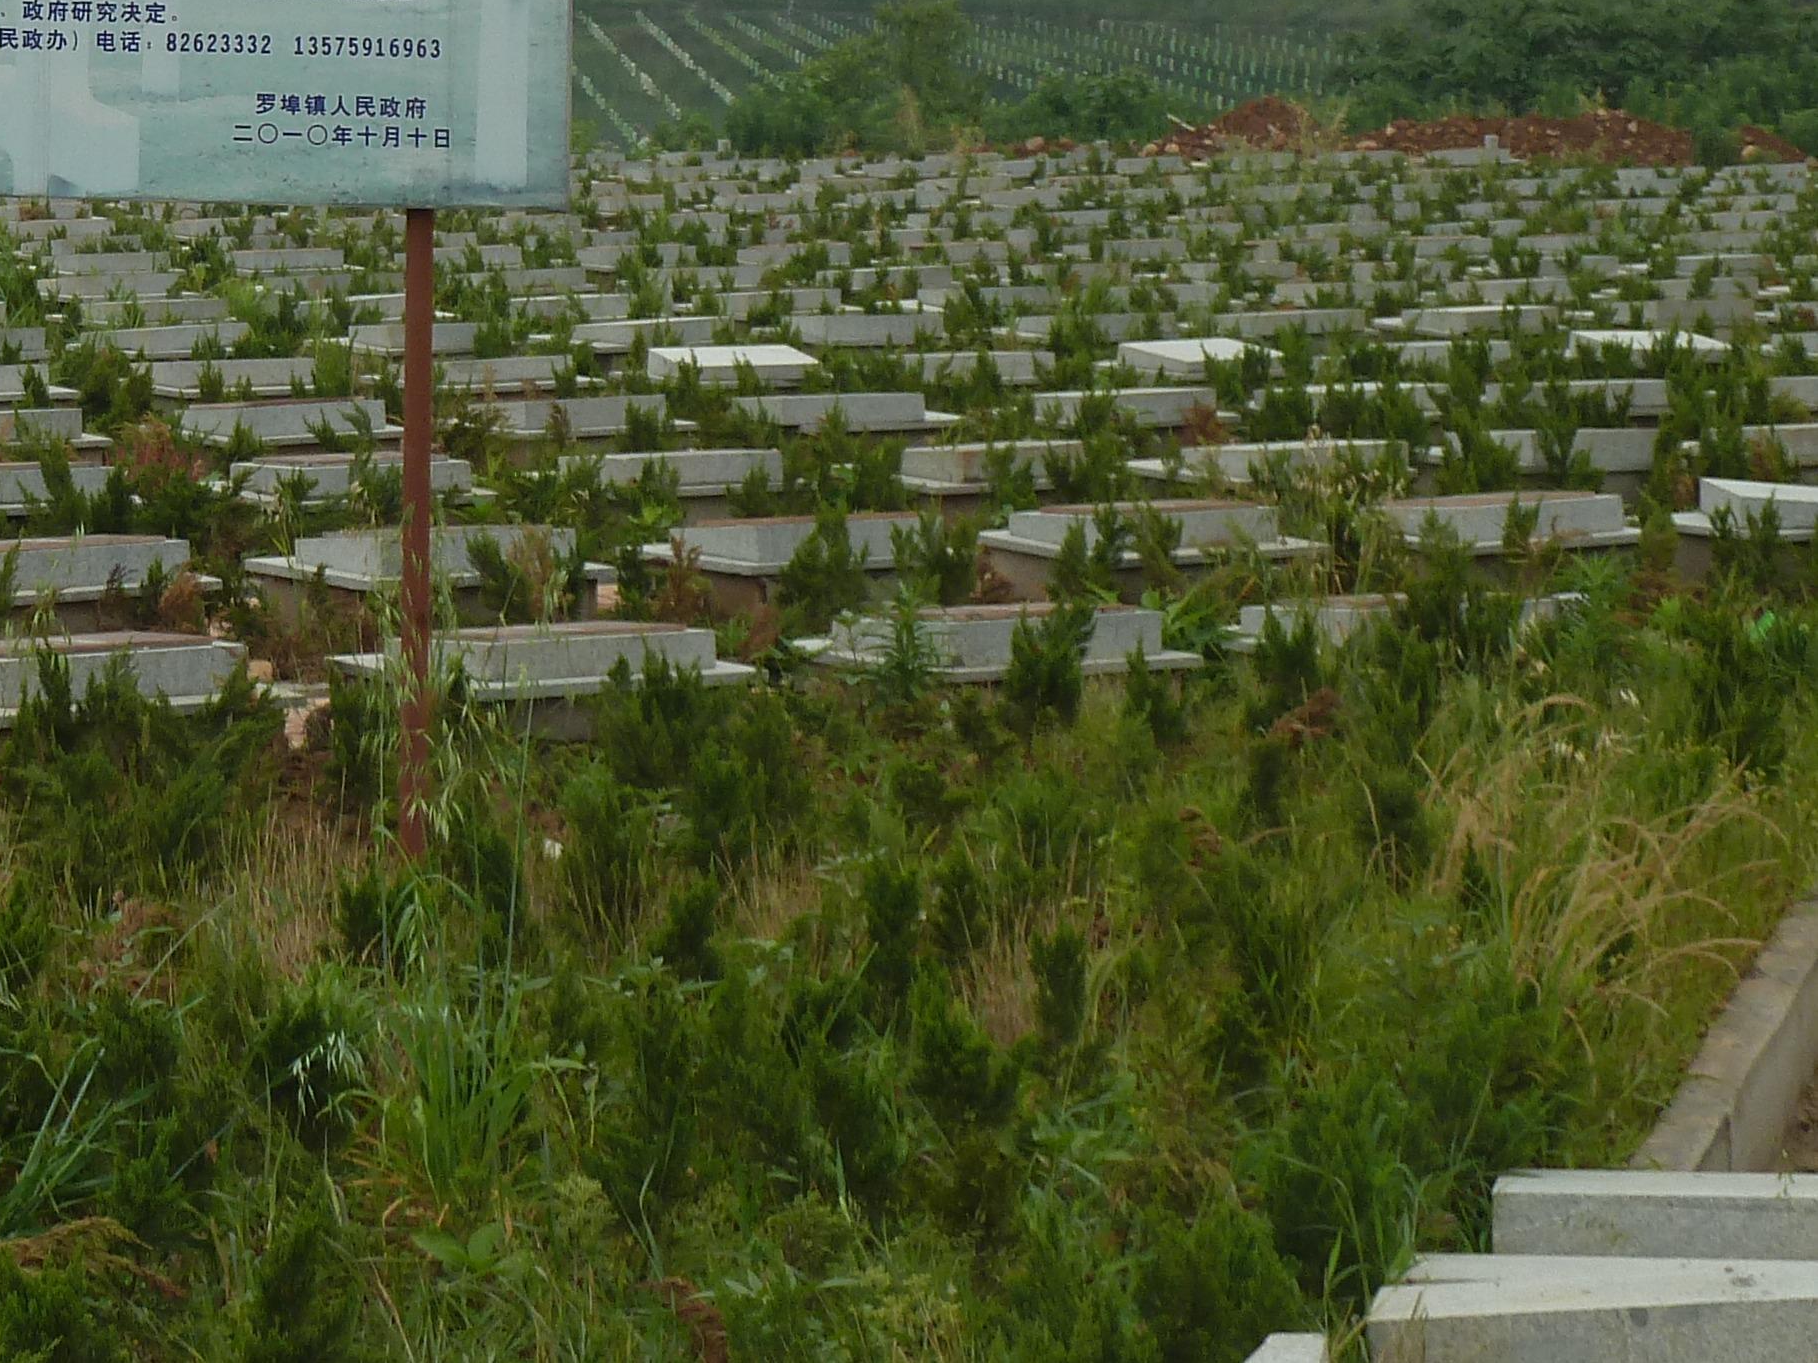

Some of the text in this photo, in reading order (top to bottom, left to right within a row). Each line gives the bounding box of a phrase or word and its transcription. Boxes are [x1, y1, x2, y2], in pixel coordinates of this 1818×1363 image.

[293, 35, 441, 59] 13575916963
[255, 93, 427, 120] 罗埠镇人民政府
